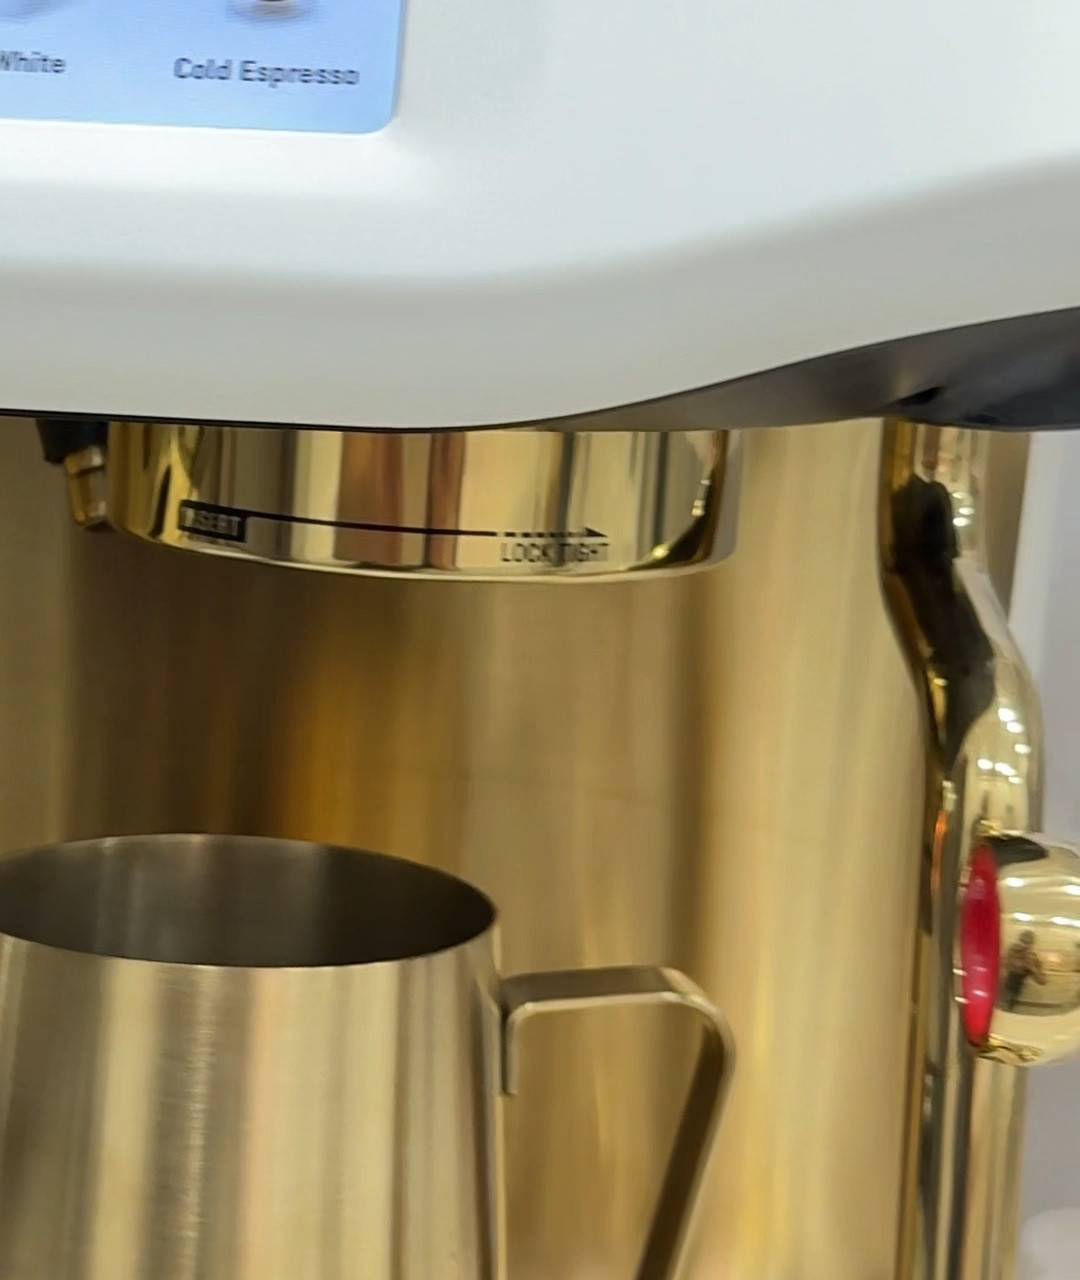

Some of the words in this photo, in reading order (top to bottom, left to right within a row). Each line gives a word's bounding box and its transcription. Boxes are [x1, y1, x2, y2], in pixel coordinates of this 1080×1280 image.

[174, 57, 232, 80] Cold
[239, 59, 360, 89] Espresso
[500, 542, 551, 563] LOCK
[559, 542, 610, 563] TIGHT
